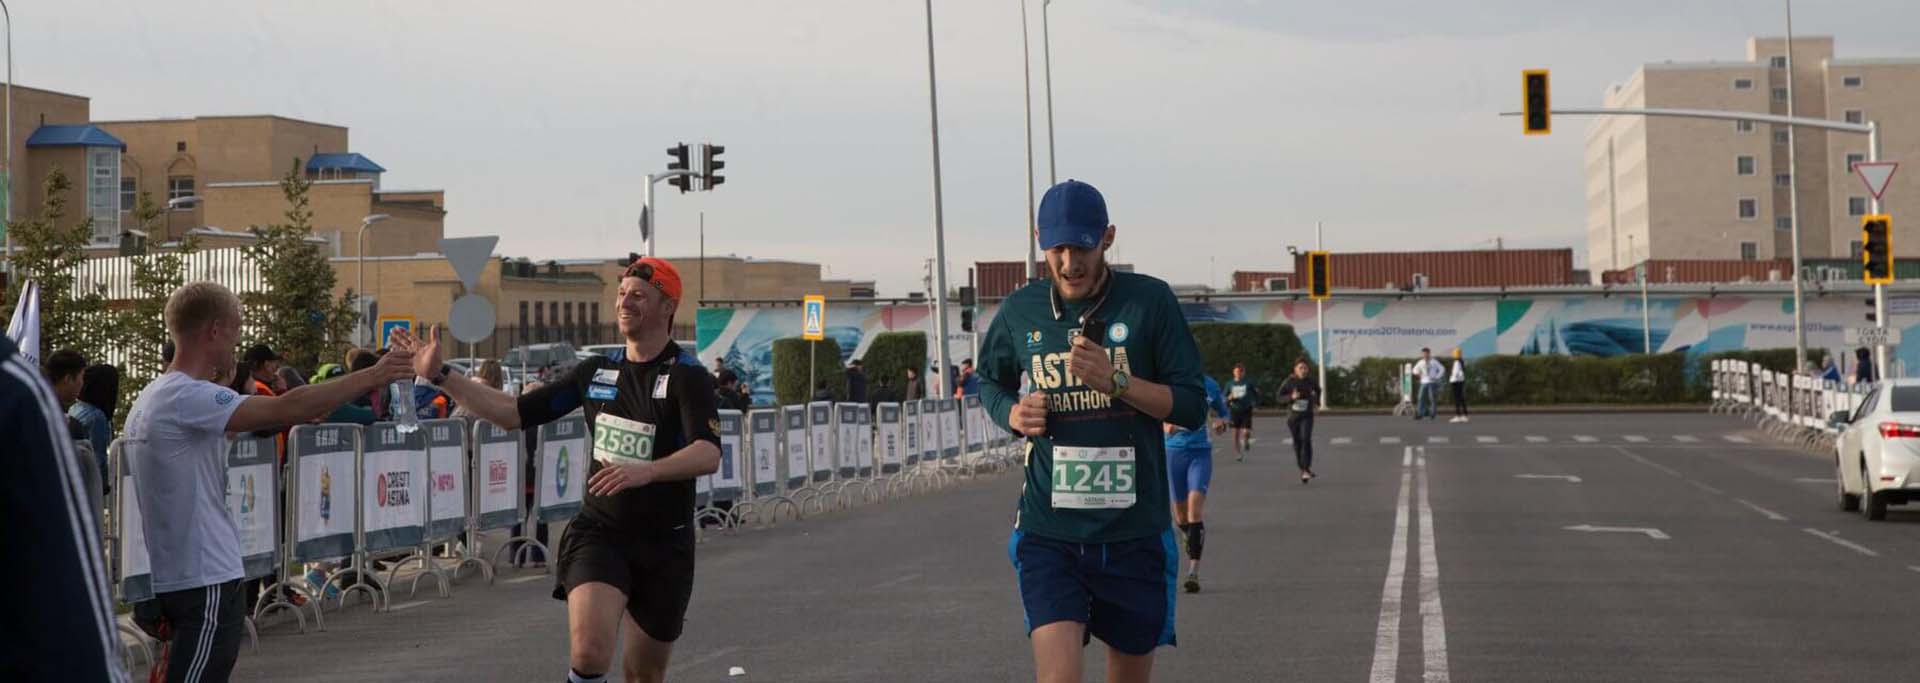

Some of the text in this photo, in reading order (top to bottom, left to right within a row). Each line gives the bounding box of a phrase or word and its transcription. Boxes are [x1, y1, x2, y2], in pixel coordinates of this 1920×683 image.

[1032, 346, 1130, 389] ASTA
[1046, 390, 1112, 412] ARATHON
[595, 426, 652, 458] 2580
[1055, 463, 1133, 491] 1245
